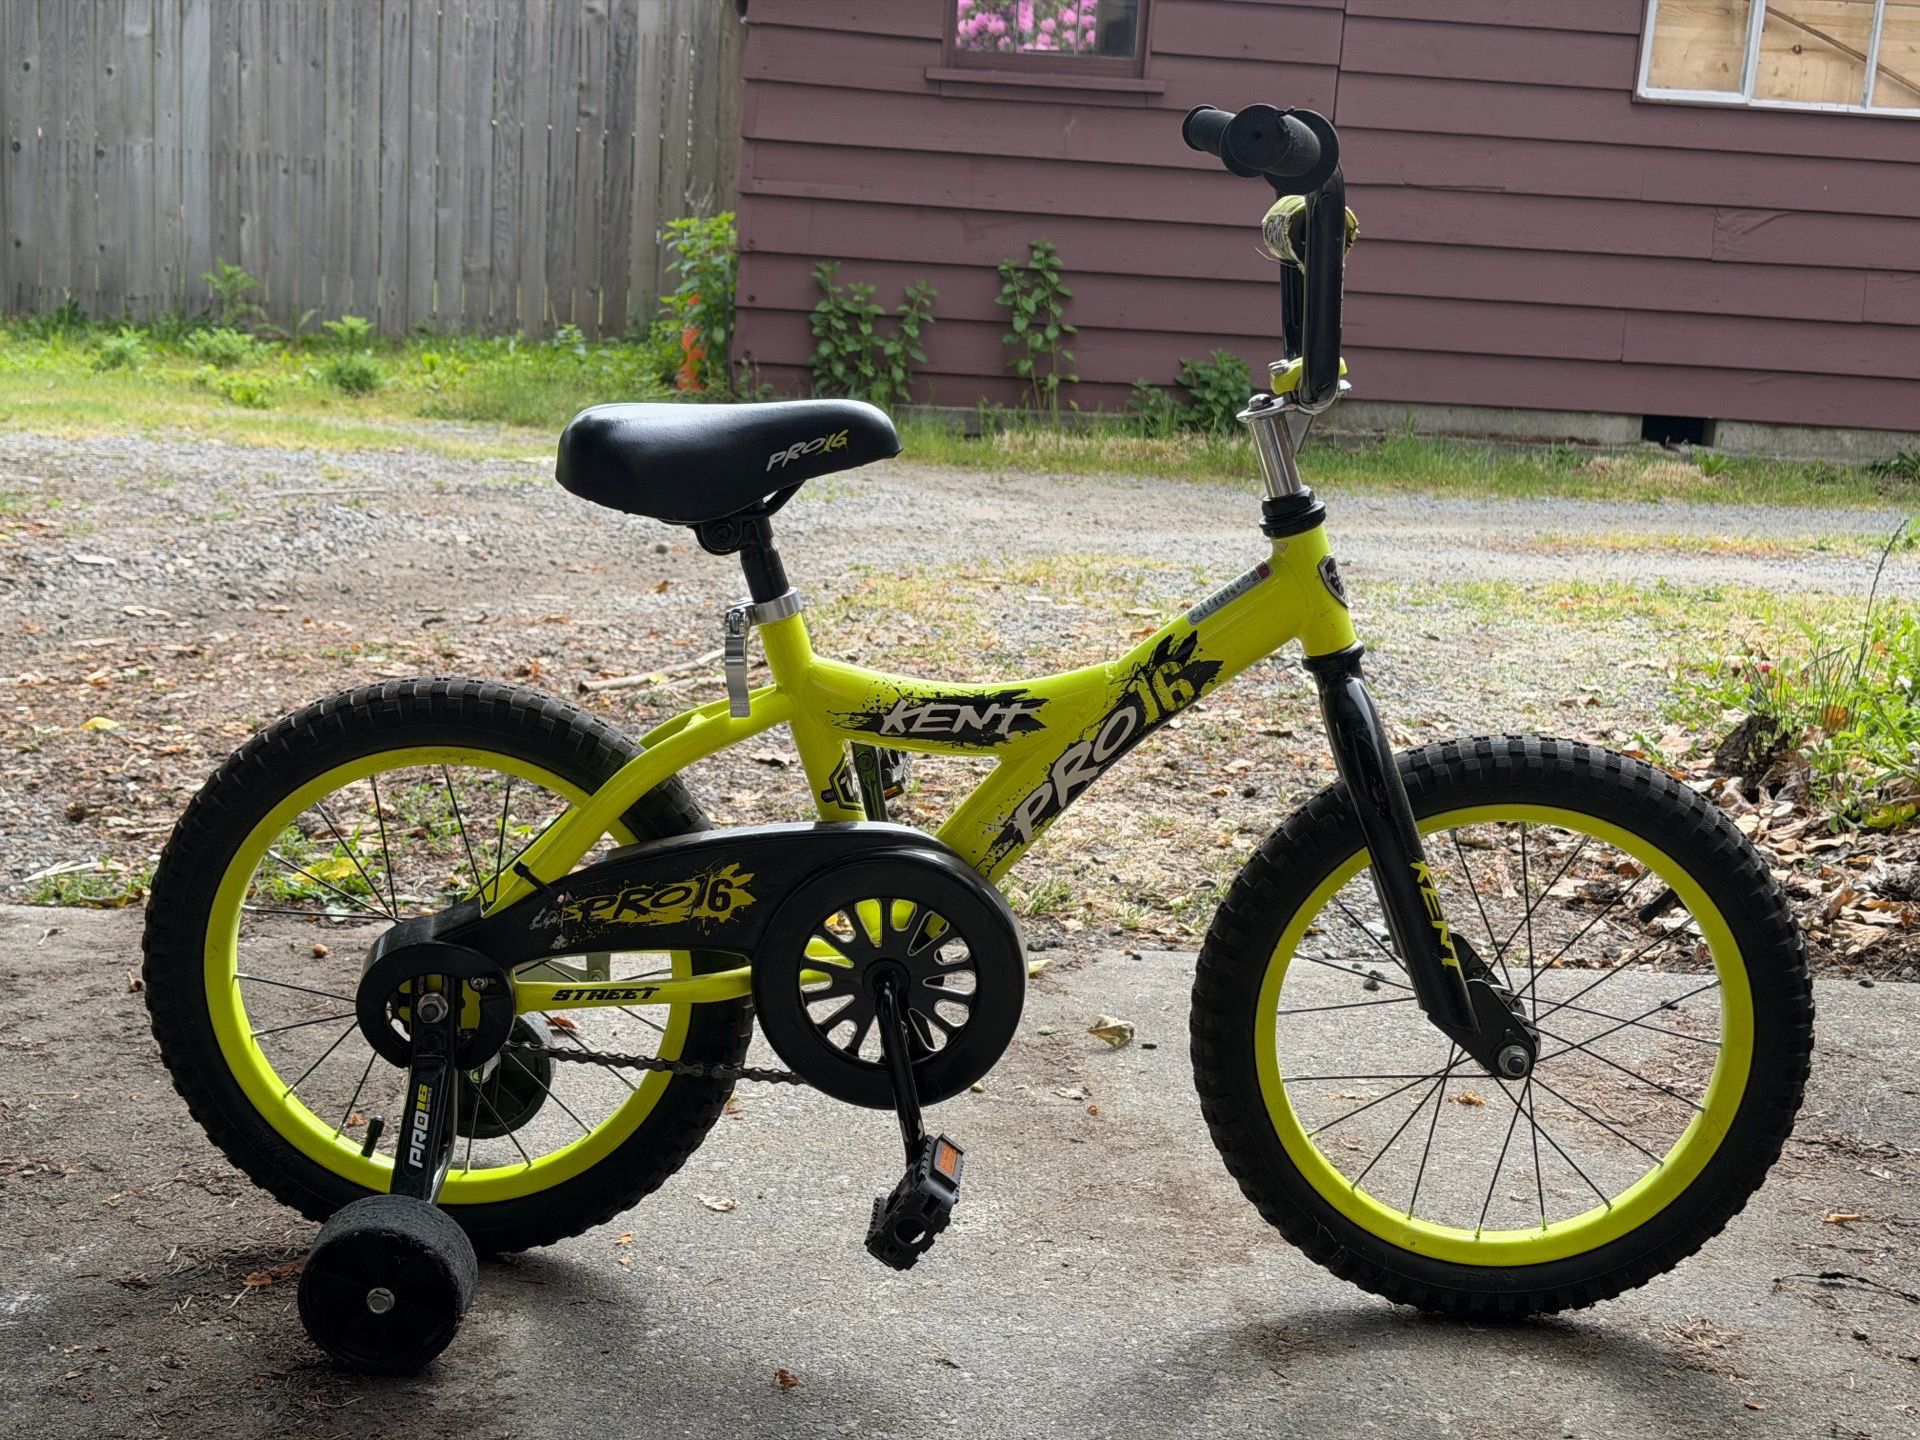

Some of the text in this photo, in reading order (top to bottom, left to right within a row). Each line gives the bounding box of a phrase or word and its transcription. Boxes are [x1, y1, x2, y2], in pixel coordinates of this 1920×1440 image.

[880, 699, 1027, 735] KENT
[1409, 859, 1461, 975] KENT
[551, 986, 660, 1001] STREET
